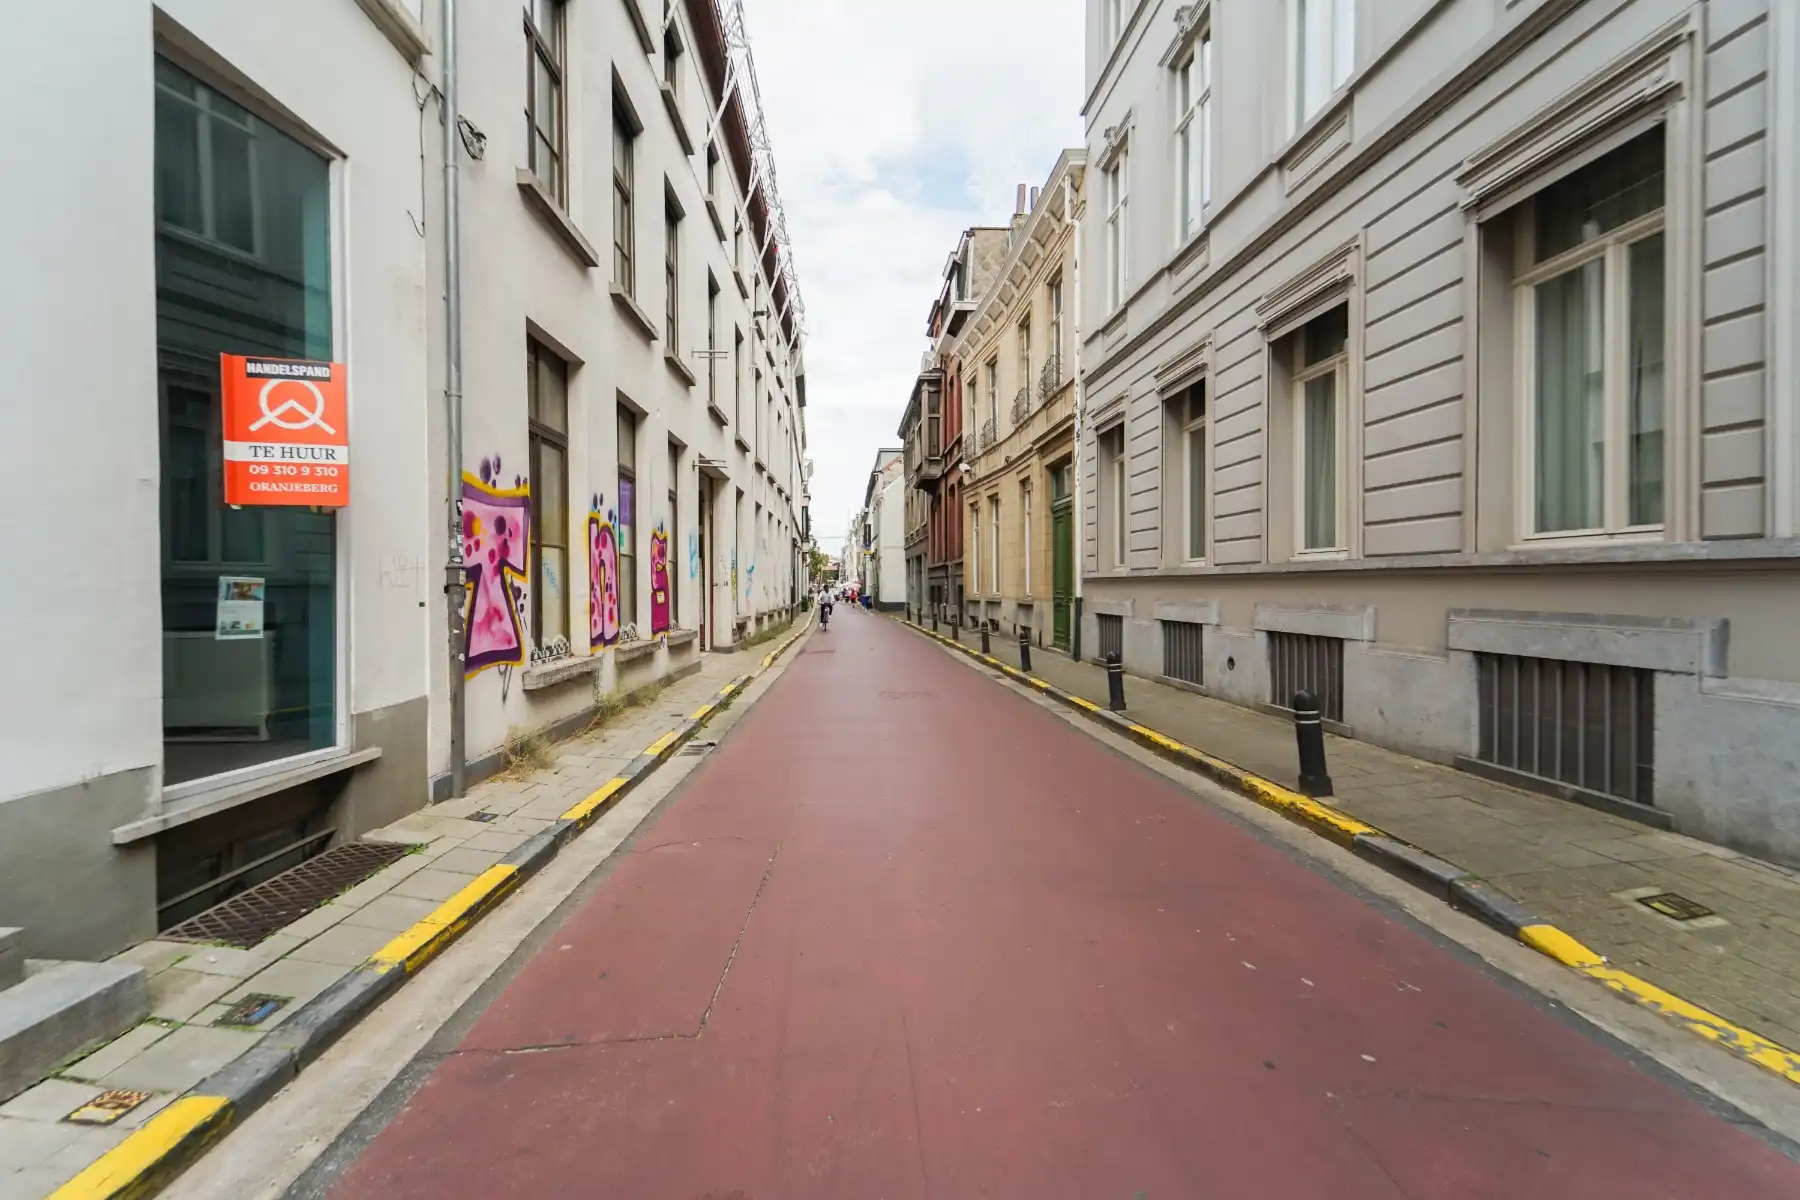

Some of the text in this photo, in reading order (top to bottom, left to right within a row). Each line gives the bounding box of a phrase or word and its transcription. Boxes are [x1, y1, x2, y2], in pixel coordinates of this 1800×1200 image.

[246, 362, 330, 377] HANDELSPAND
[249, 445, 337, 460] TE HUUR
[249, 464, 338, 477] 09 310 9 310
[249, 482, 338, 493] ORANJEBERG
